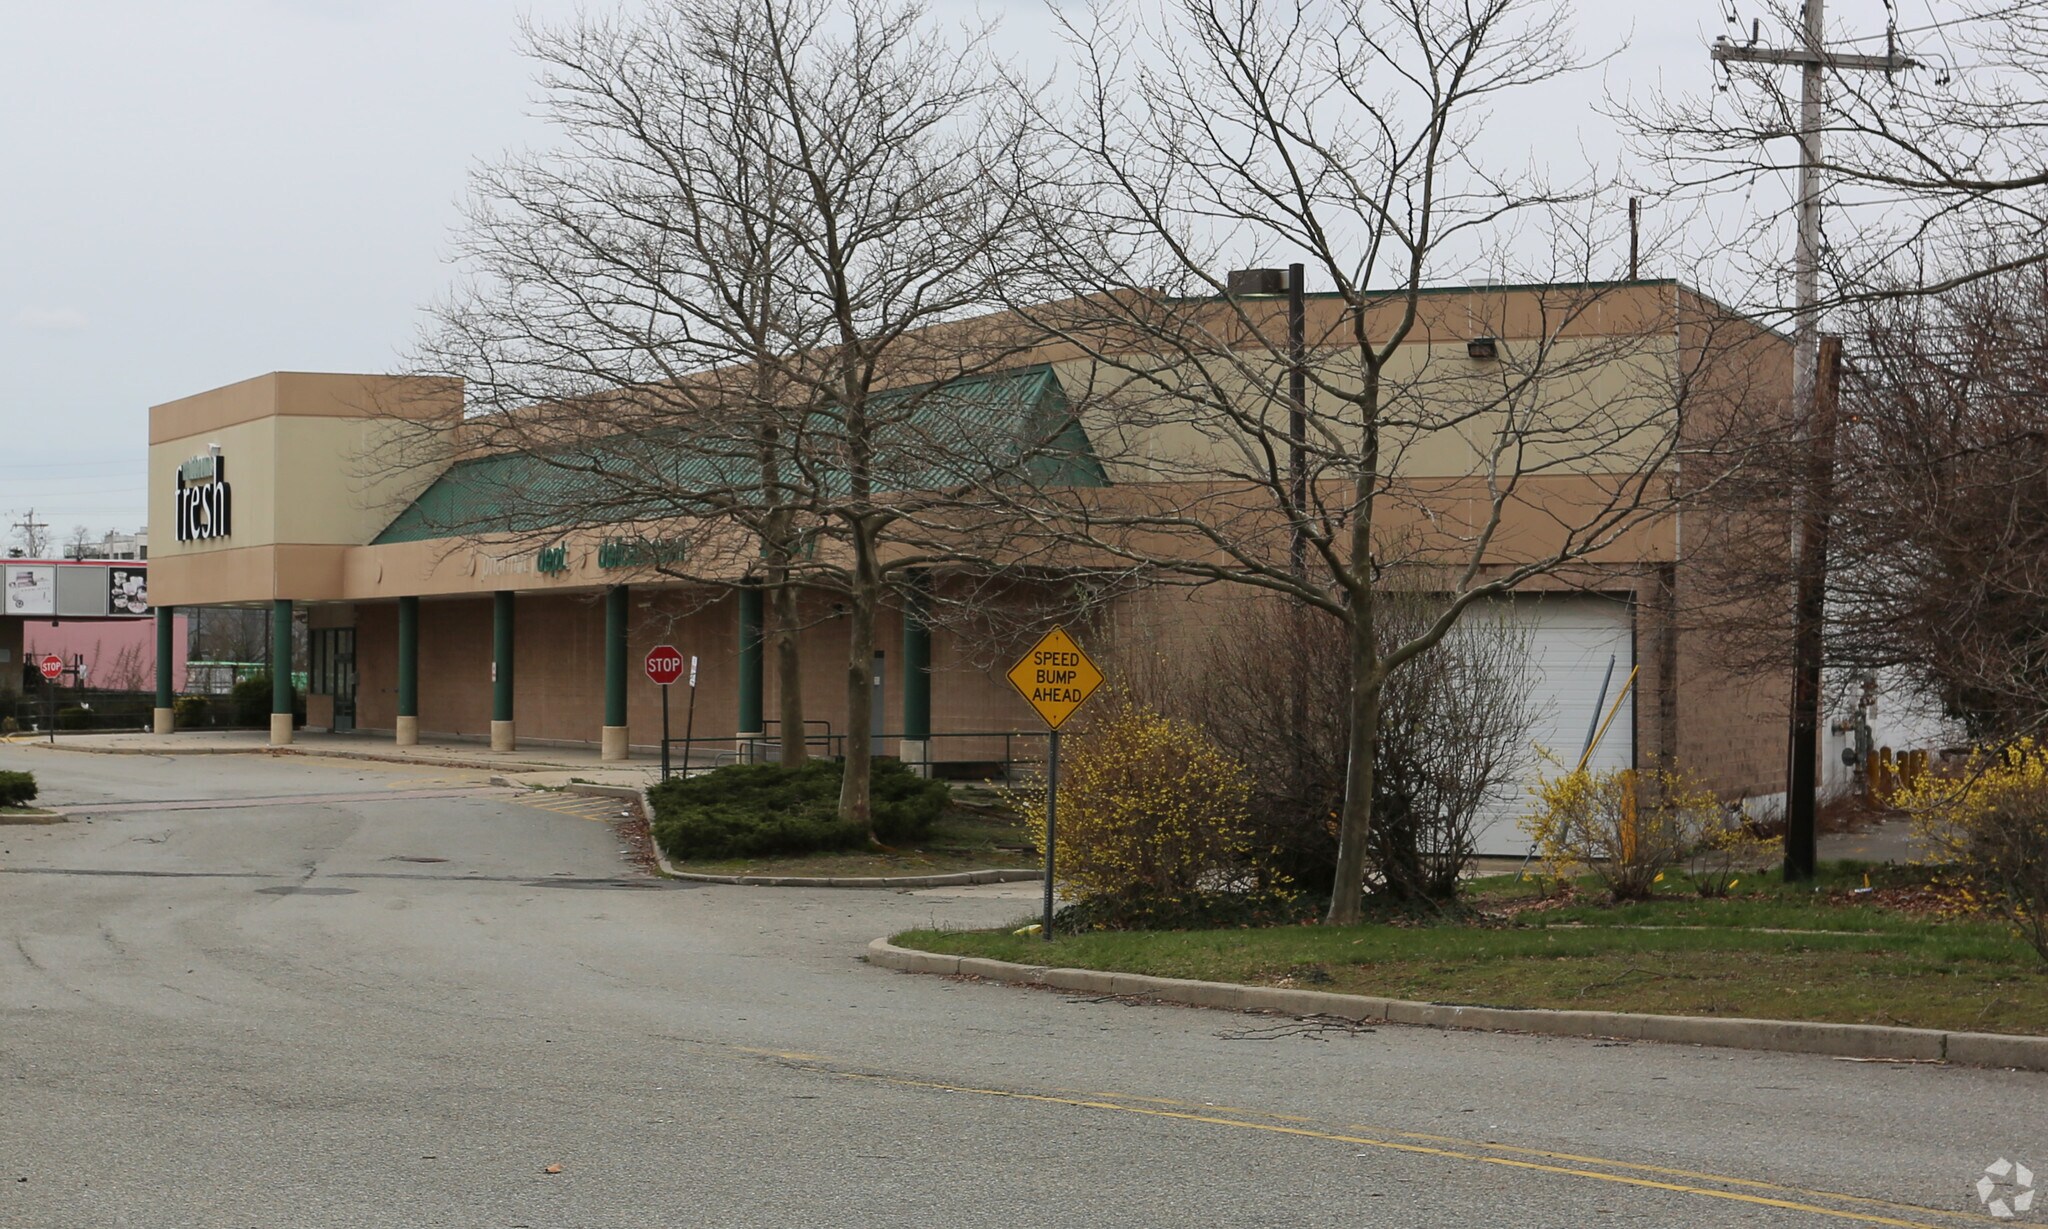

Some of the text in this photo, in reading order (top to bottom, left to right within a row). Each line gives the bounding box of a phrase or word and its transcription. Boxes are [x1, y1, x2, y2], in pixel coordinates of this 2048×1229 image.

[175, 456, 226, 541] fresh
[648, 658, 680, 672] STOP
[1034, 651, 1080, 667] SPEED
[42, 662, 61, 672] STOP
[1036, 669, 1077, 684] BUMP
[1032, 687, 1082, 703] AHEAD
